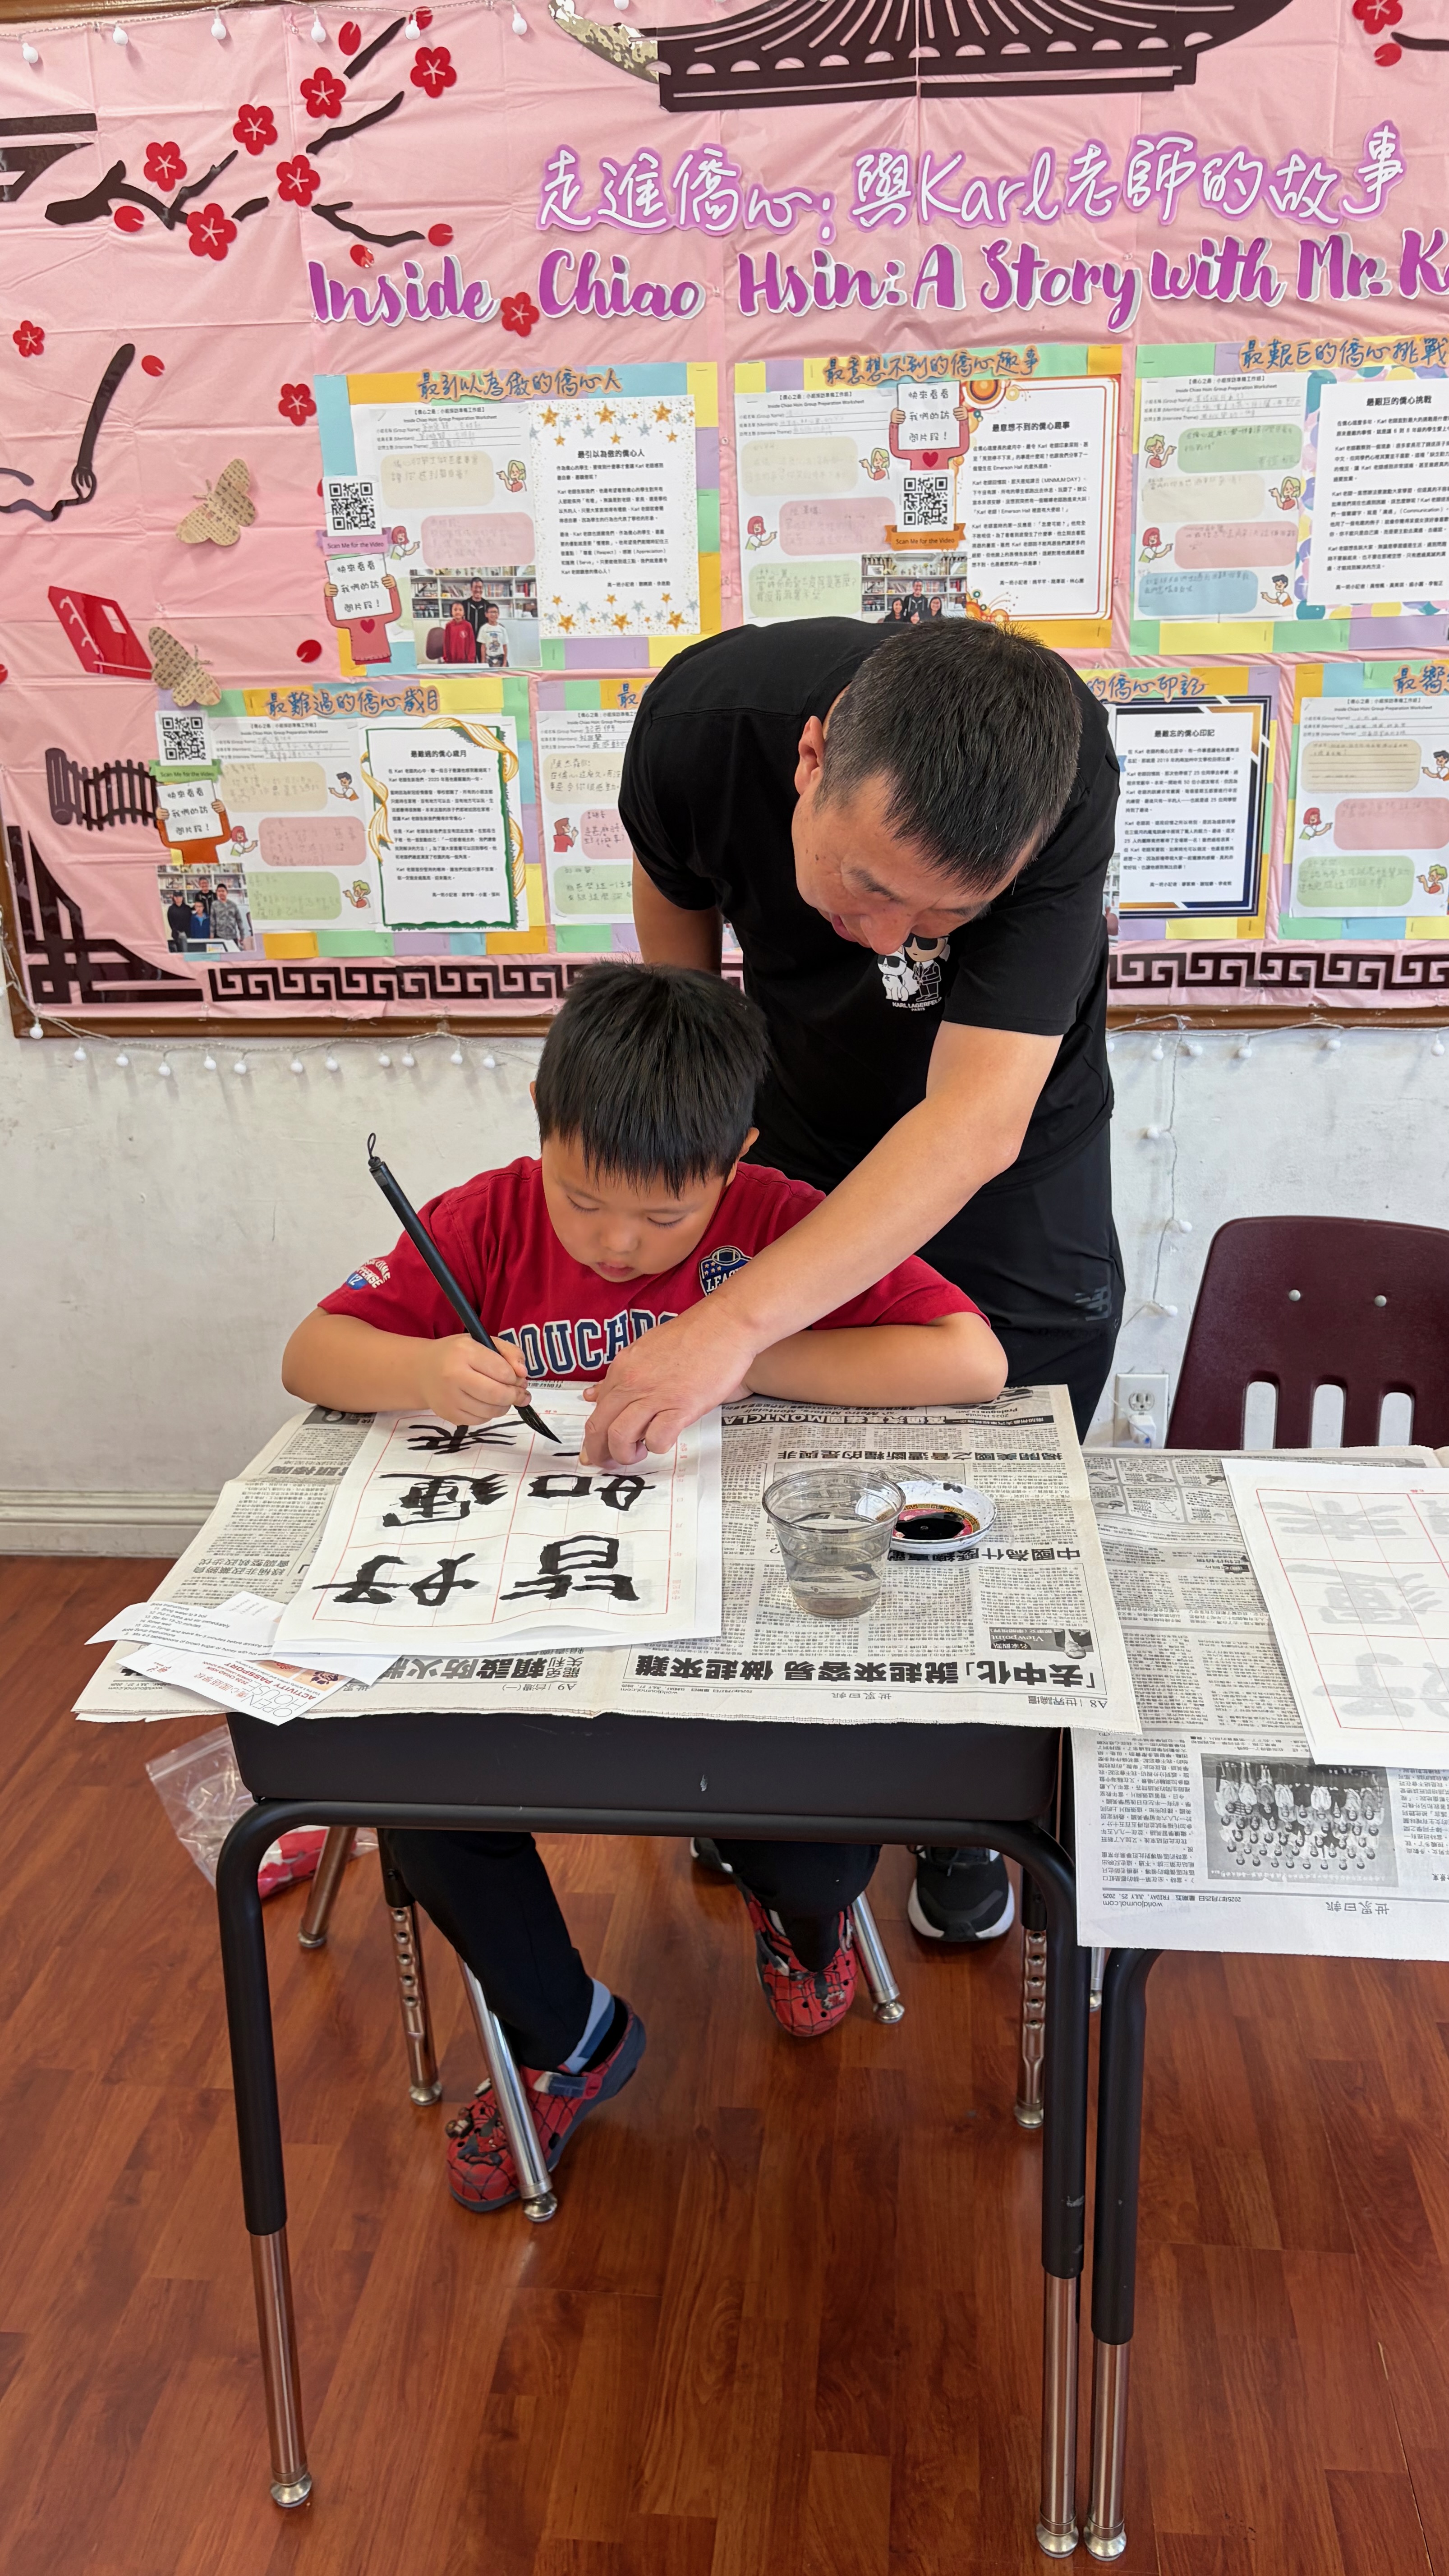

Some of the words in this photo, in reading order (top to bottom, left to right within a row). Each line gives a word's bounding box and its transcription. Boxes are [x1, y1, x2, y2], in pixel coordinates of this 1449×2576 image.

[309, 253, 500, 327] Inside
[538, 248, 706, 319] Chiao
[738, 246, 907, 317] Hsin:
[911, 243, 967, 311] A
[978, 236, 1141, 333] Story
[1149, 234, 1285, 307] with
[1295, 231, 1398, 302] Mr.
[825, 348, 1039, 383] 最意想不到的僑心趣事
[1394, 665, 1449, 694] 最響
[908, 997, 942, 1009] LAGERFELD
[348, 1274, 363, 1286] 12
[497, 1309, 679, 1379] OUCHD
[990, 1633, 1044, 1642] Viewpoint
[547, 1657, 584, 1667] 失利
[635, 1655, 774, 1681] 做起來難
[224, 1662, 272, 1684] PASSPORT
[545, 1667, 580, 1678] 罷免
[784, 1660, 1096, 1689] 「去中化」說起來容易
[242, 1680, 308, 1711] HOUSE
[273, 1683, 317, 1700] ACTIVITY
[830, 1691, 892, 1700] 世界日報
[240, 1693, 293, 1718] OPEN
[1089, 1698, 1109, 1708] A8
[1103, 1900, 1163, 1908] worldjournal.com
[1325, 1900, 1390, 1915] 世界日報
